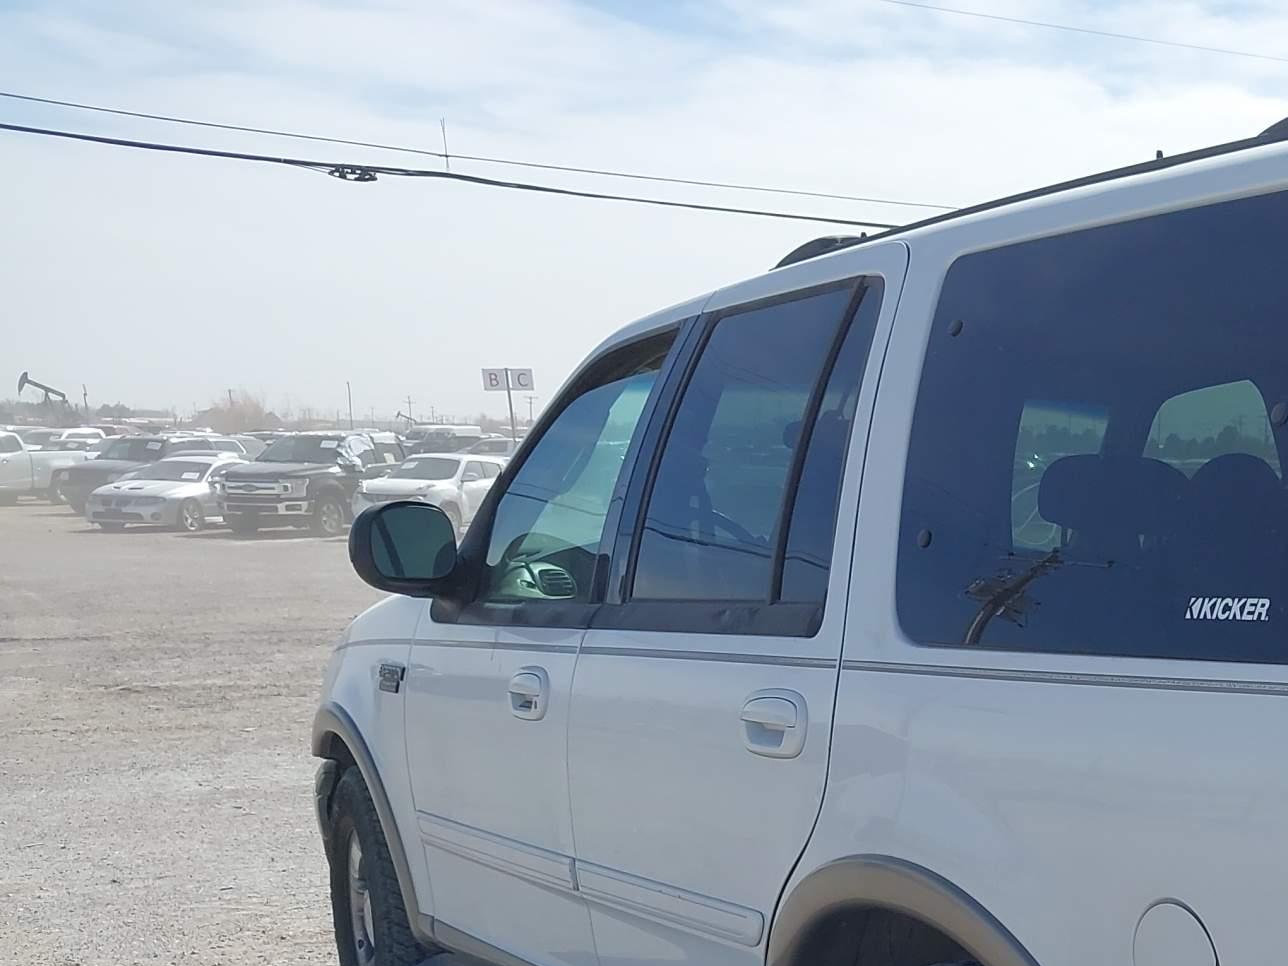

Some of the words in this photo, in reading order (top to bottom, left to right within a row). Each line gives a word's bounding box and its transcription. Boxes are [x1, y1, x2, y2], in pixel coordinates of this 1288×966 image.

[488, 372, 500, 388] B
[517, 372, 529, 388] C
[1198, 596, 1270, 621] KICKER
